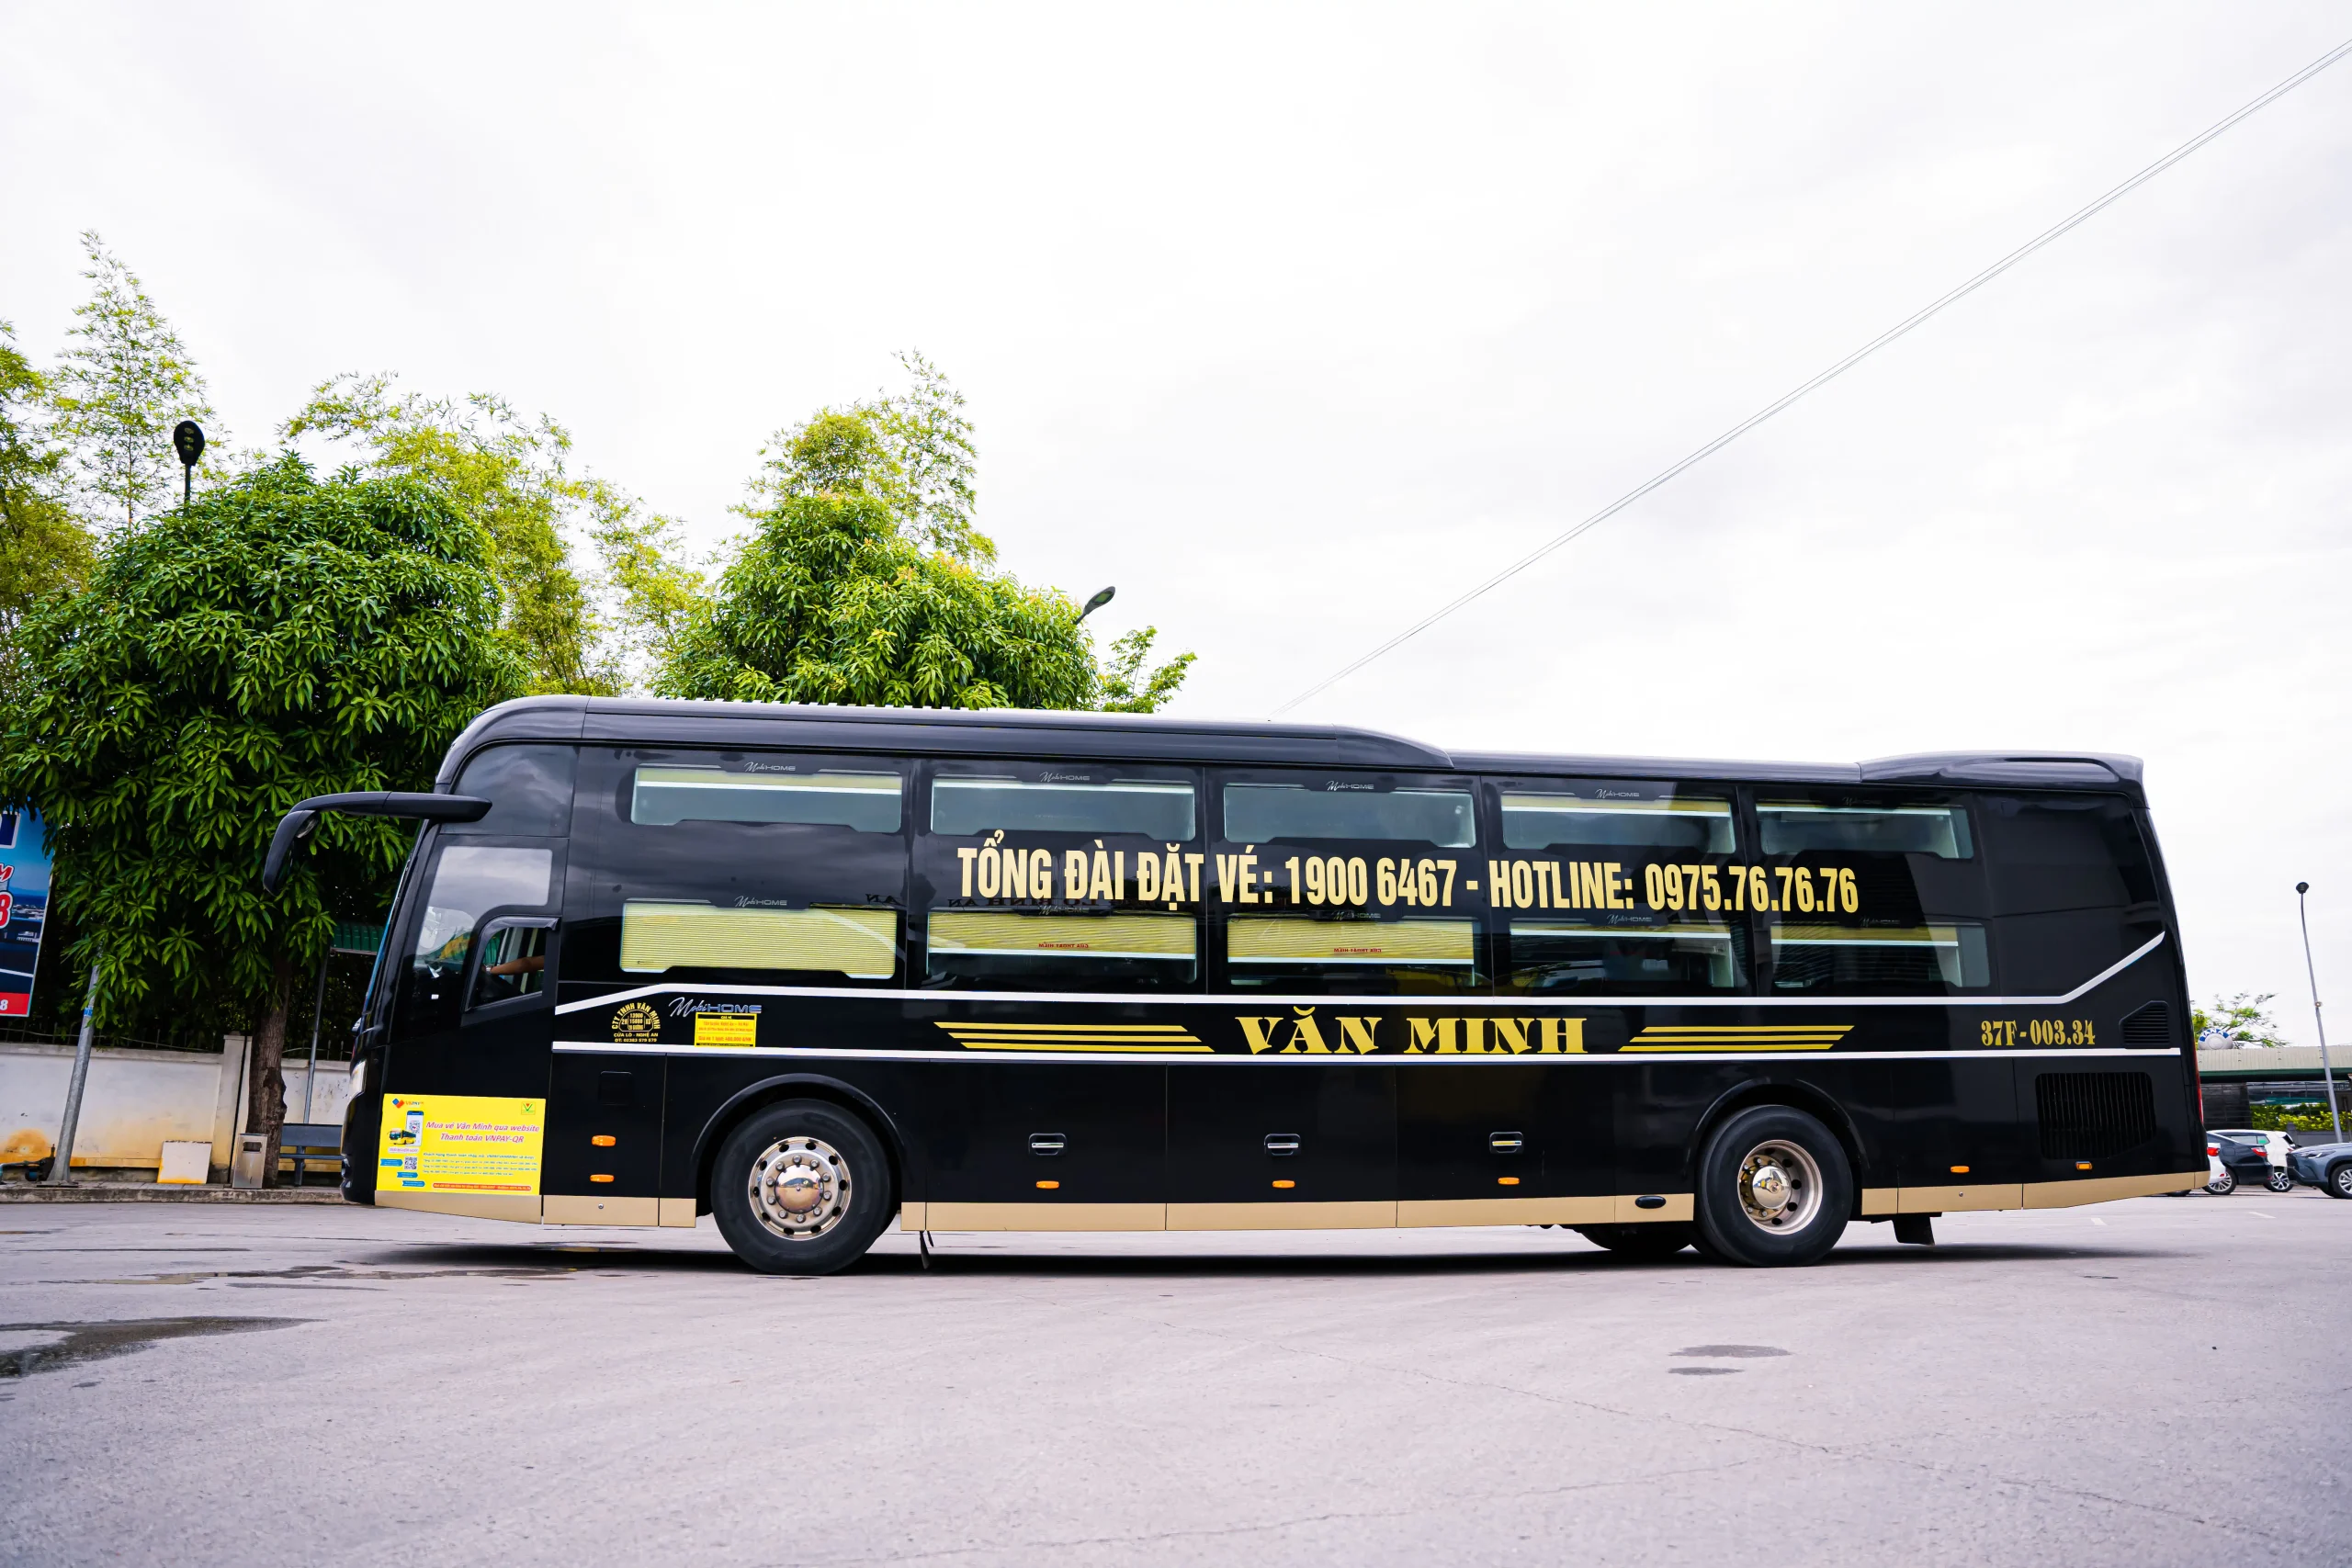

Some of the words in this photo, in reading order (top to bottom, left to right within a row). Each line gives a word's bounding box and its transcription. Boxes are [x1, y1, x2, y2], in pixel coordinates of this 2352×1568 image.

[957, 829, 1052, 899] TỔNG
[1063, 840, 1125, 900] ĐÀI
[1136, 842, 1204, 911] ĐẶT
[1217, 845, 1273, 904] VÉ:
[1286, 857, 1368, 906] 1900
[1376, 858, 1457, 907] 6467
[1490, 861, 1634, 909] HOTLINE:
[1645, 864, 1859, 913] 0975.76.76.76
[668, 997, 763, 1018] MobiHOME
[1237, 1006, 1383, 1055] VĂN
[1404, 1017, 1589, 1055] MINH
[1981, 1020, 2097, 1046] 37F-003.34
[440, 1133, 464, 1141] Thanh
[510, 1124, 540, 1133] website
